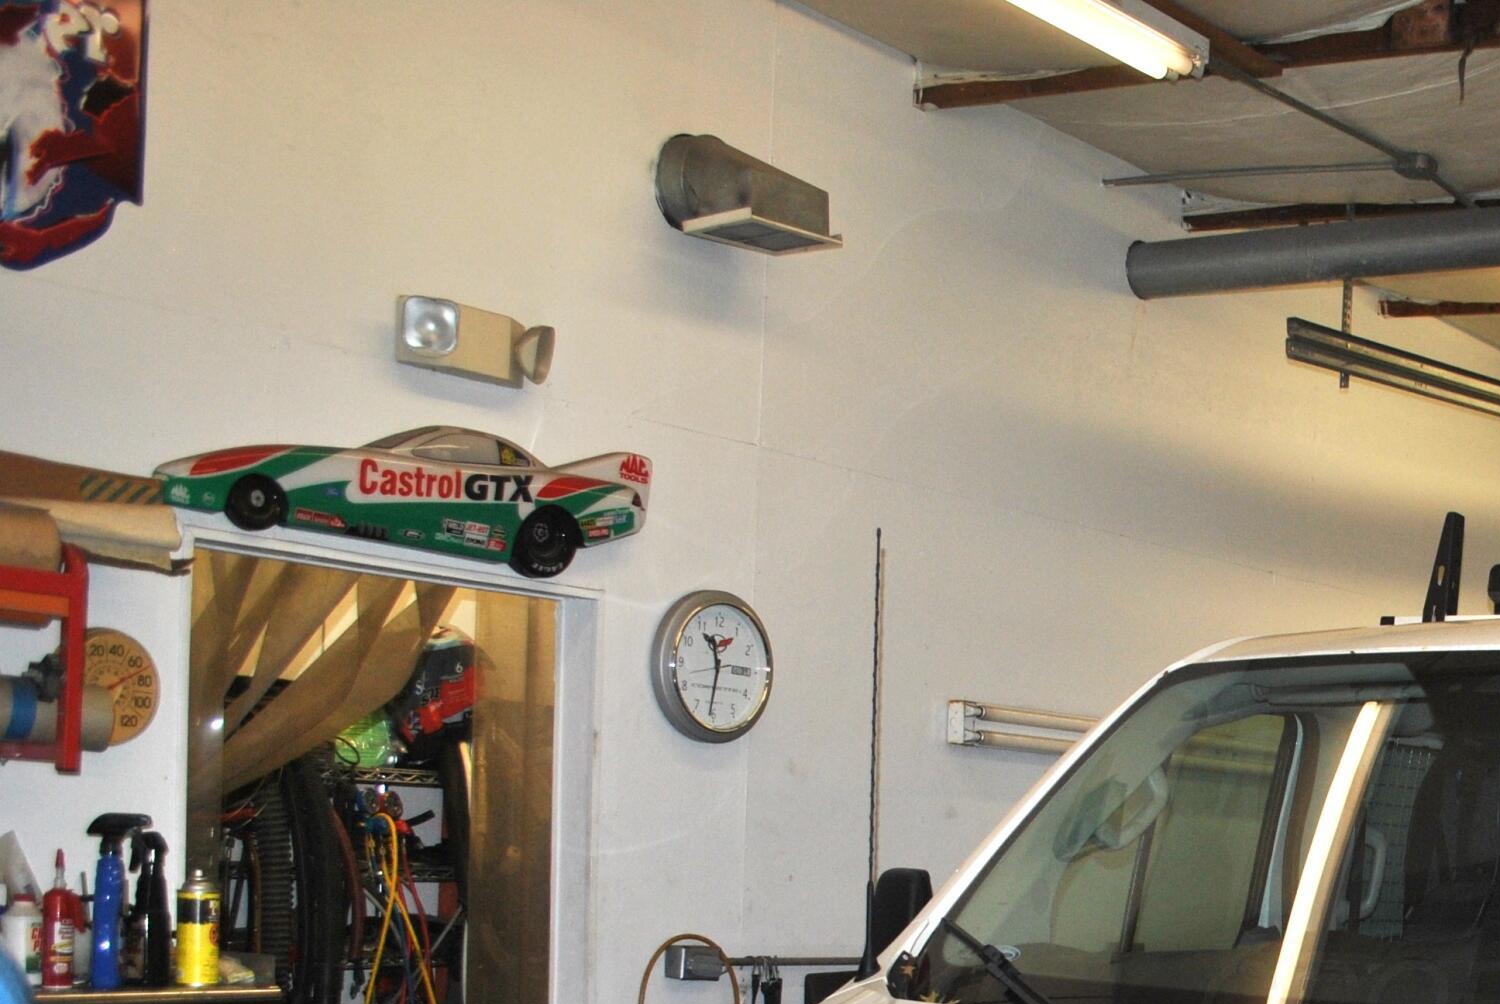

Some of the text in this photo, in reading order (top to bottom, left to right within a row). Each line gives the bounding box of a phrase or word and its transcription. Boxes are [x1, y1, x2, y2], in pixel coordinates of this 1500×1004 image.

[698, 620, 707, 631] 11
[715, 616, 725, 628] 12
[684, 636, 694, 647] 10
[90, 644, 104, 657] 20
[109, 644, 125, 657] 40
[744, 644, 751, 656] 2
[128, 656, 142, 668] 60
[455, 662, 464, 673] 6
[678, 656, 684, 667] 9
[137, 675, 152, 687] 80
[681, 680, 688, 691] 8
[743, 688, 748, 699] 4
[133, 696, 152, 709] 100
[694, 699, 700, 710] 7
[730, 703, 736, 715] 5
[121, 714, 138, 727] 120
